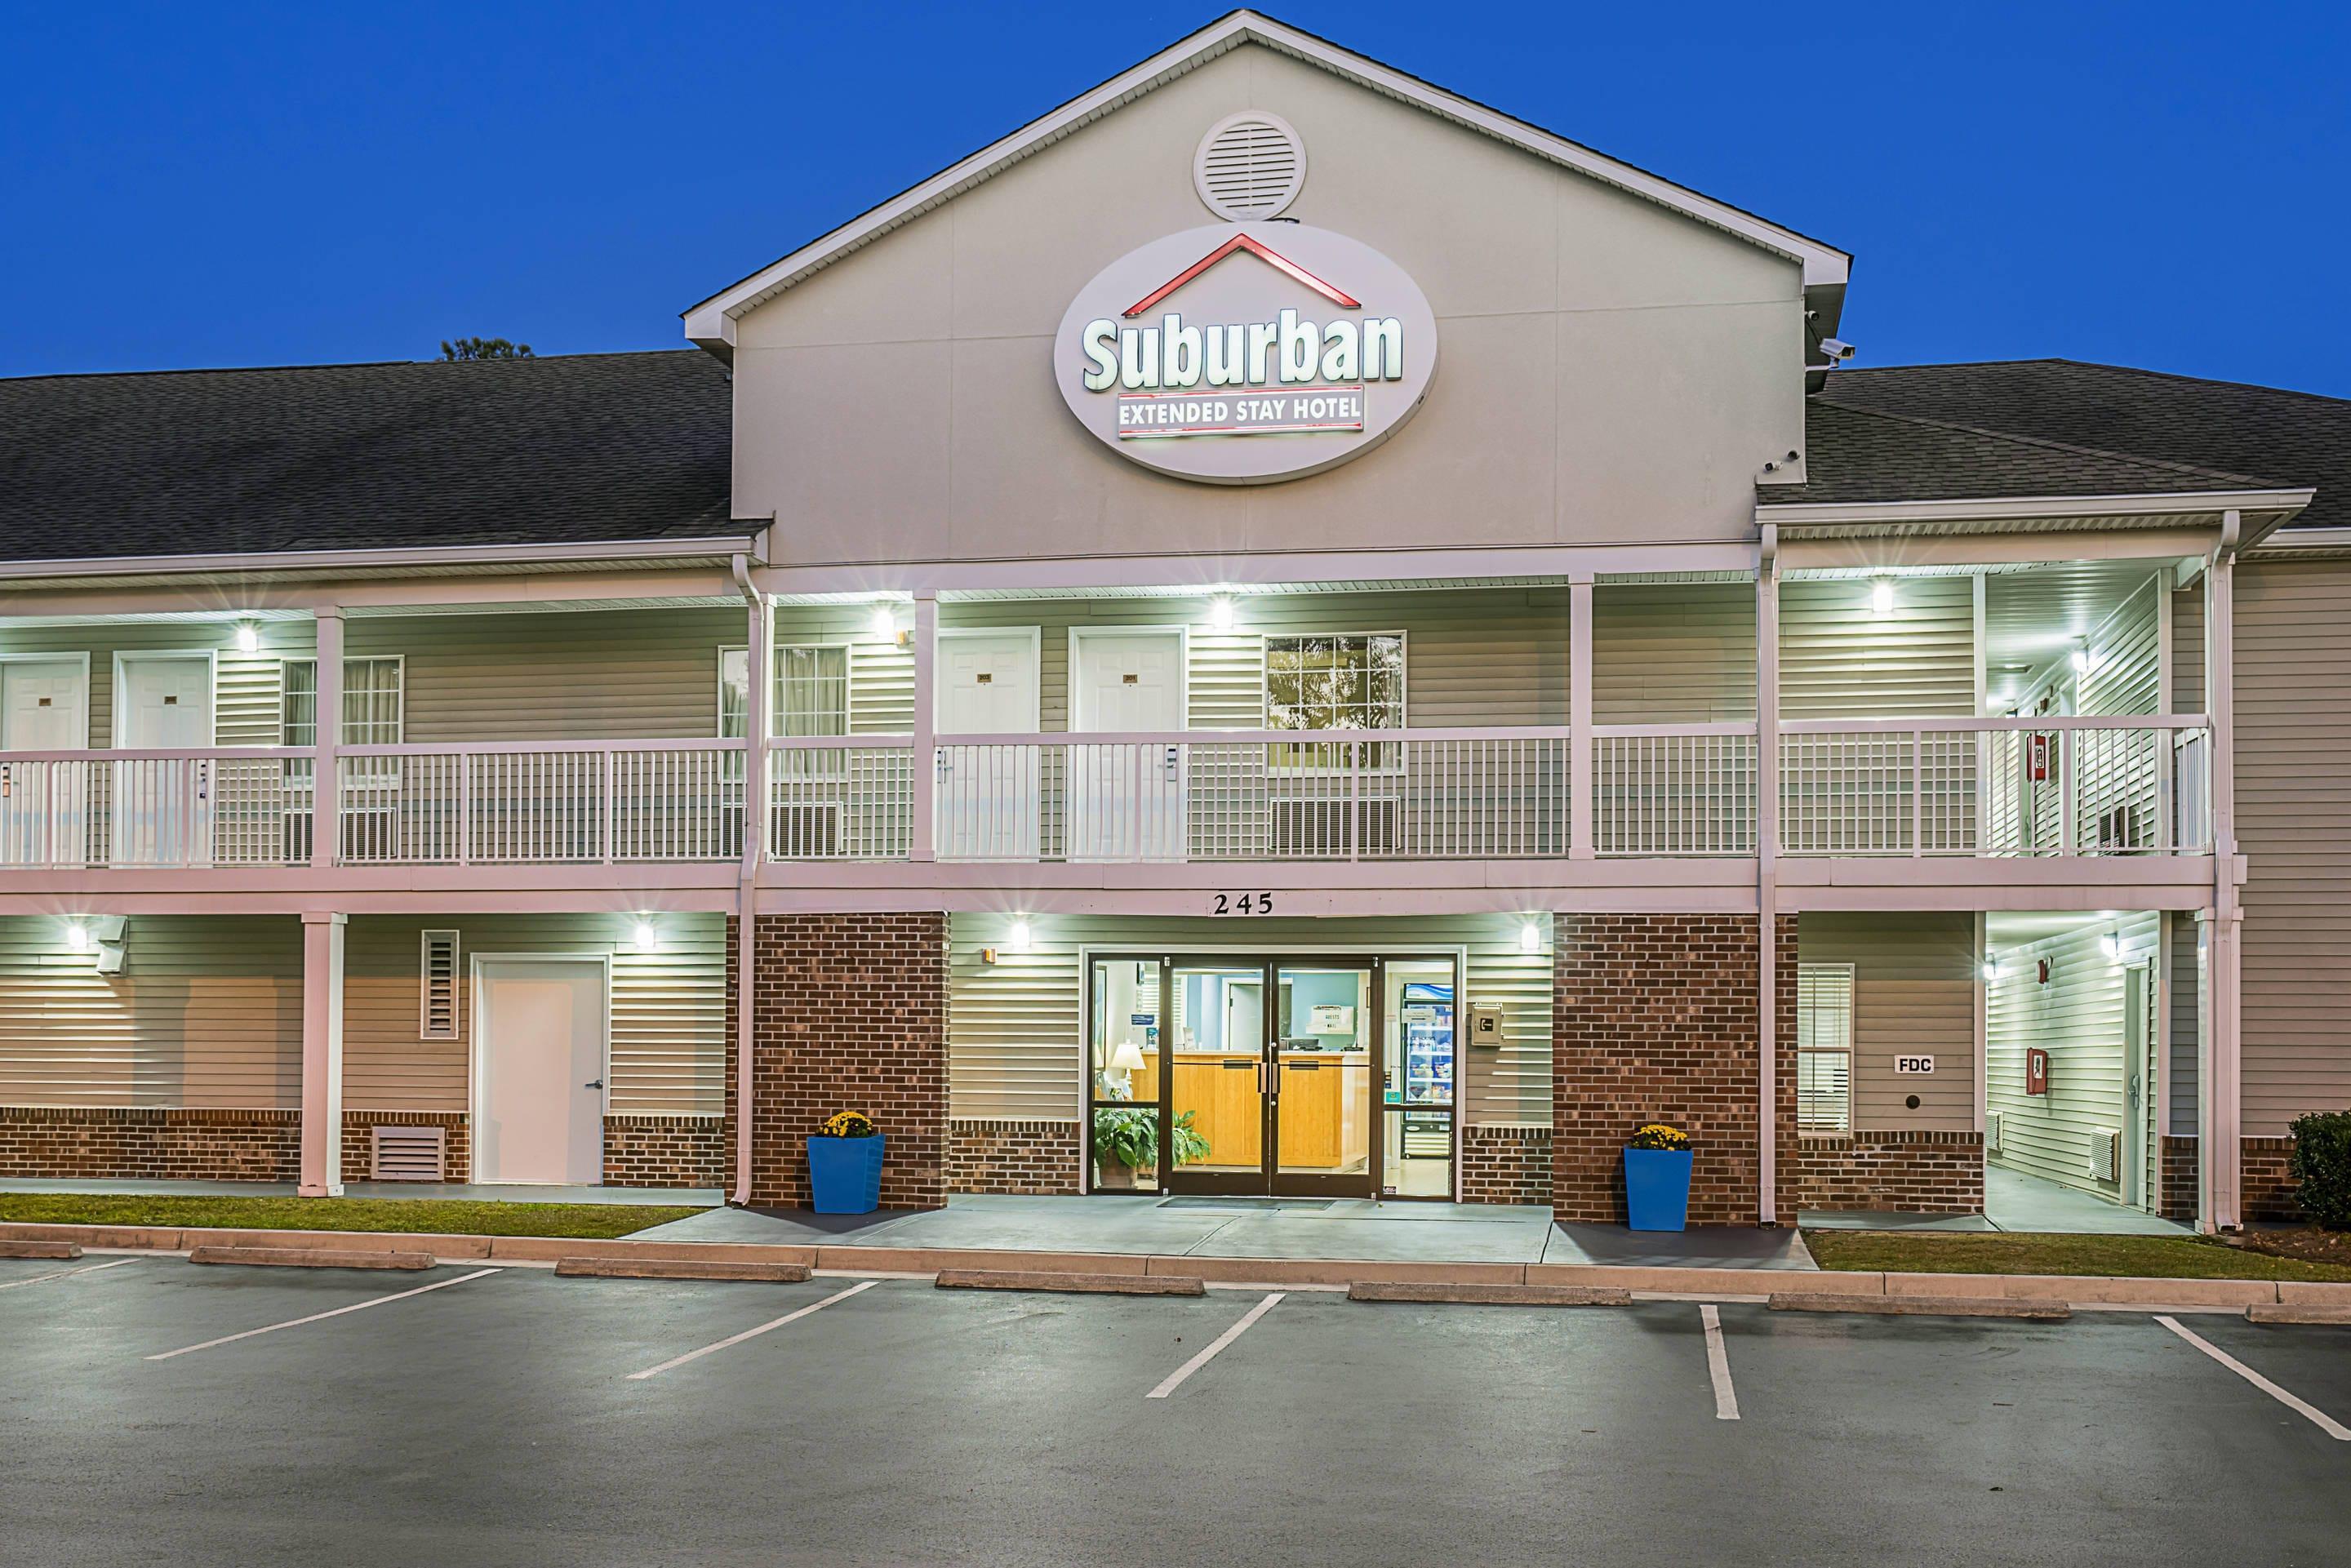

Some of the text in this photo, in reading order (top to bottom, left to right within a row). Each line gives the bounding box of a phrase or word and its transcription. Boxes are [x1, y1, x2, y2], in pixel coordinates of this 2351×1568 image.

[1082, 309, 1403, 393] Suburban
[1119, 398, 1361, 424] EXTENDED STAY HOTEL
[1214, 891, 1273, 915] 245
[1900, 1058, 1931, 1072] FDC
